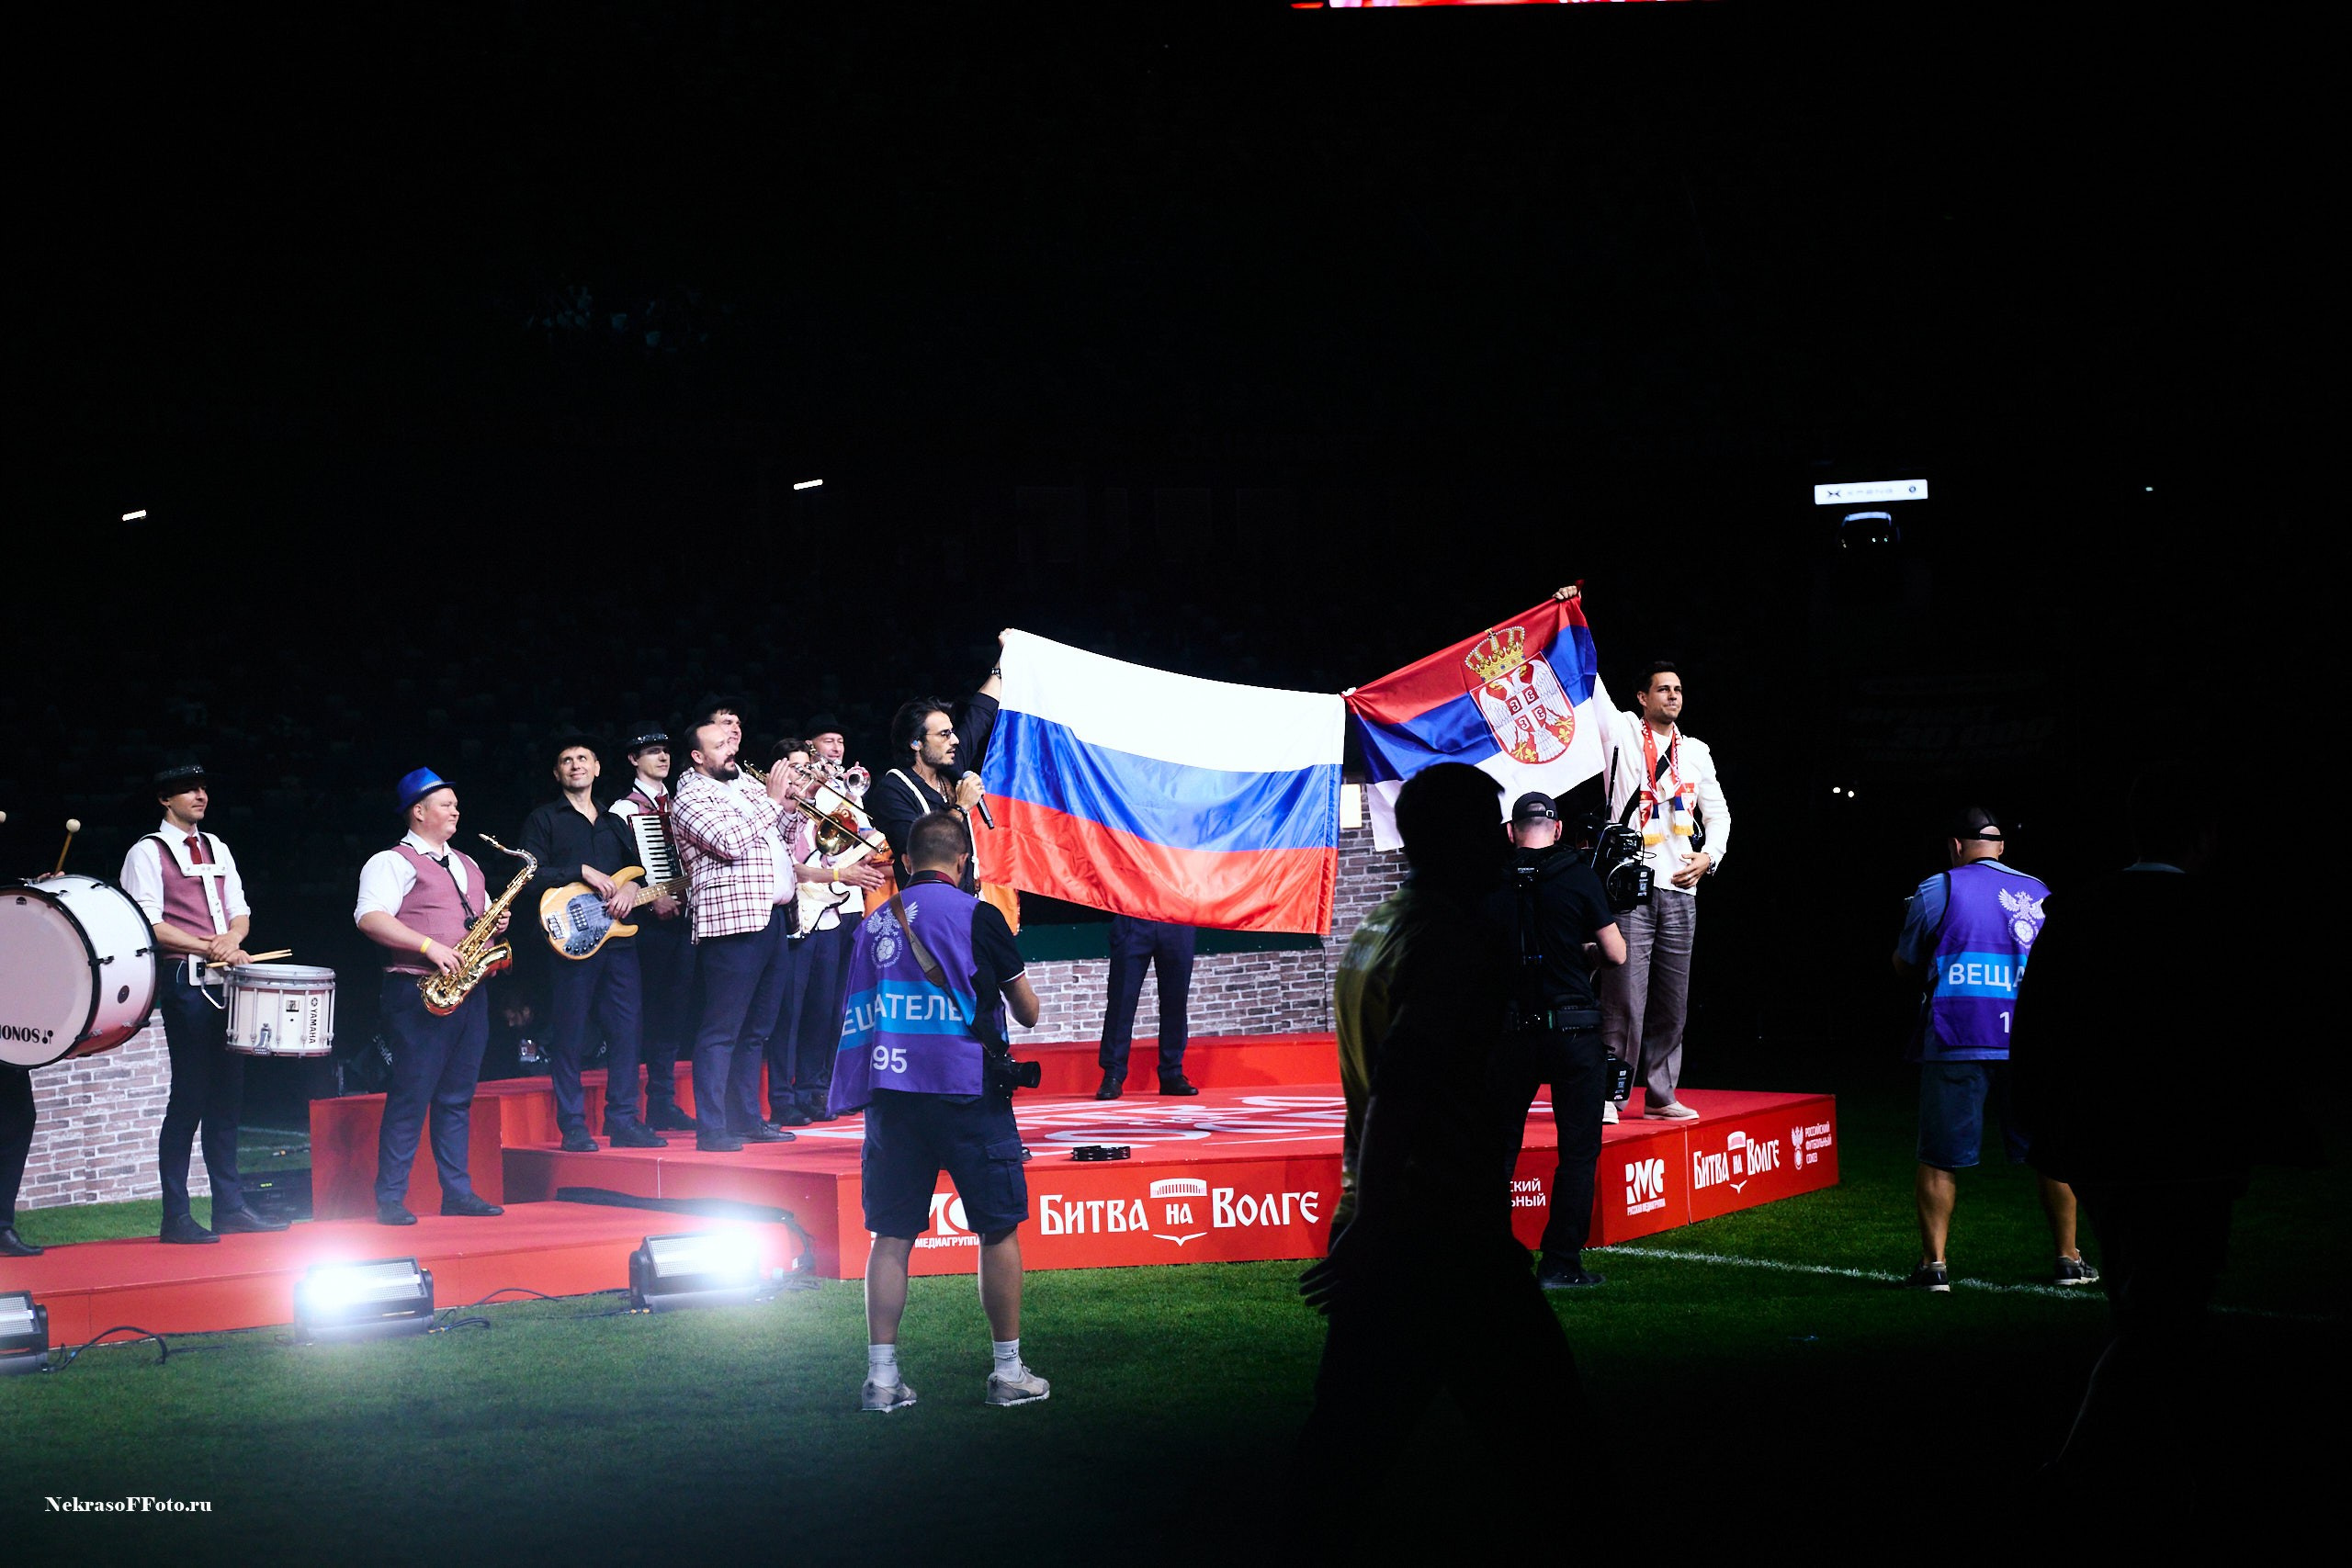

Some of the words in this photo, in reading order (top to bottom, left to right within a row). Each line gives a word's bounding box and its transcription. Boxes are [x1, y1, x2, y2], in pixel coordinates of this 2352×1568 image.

[309, 1008, 318, 1043] YAMAHA
[1999, 1011, 2010, 1032] 1
[0, 1024, 40, 1043] ONOS
